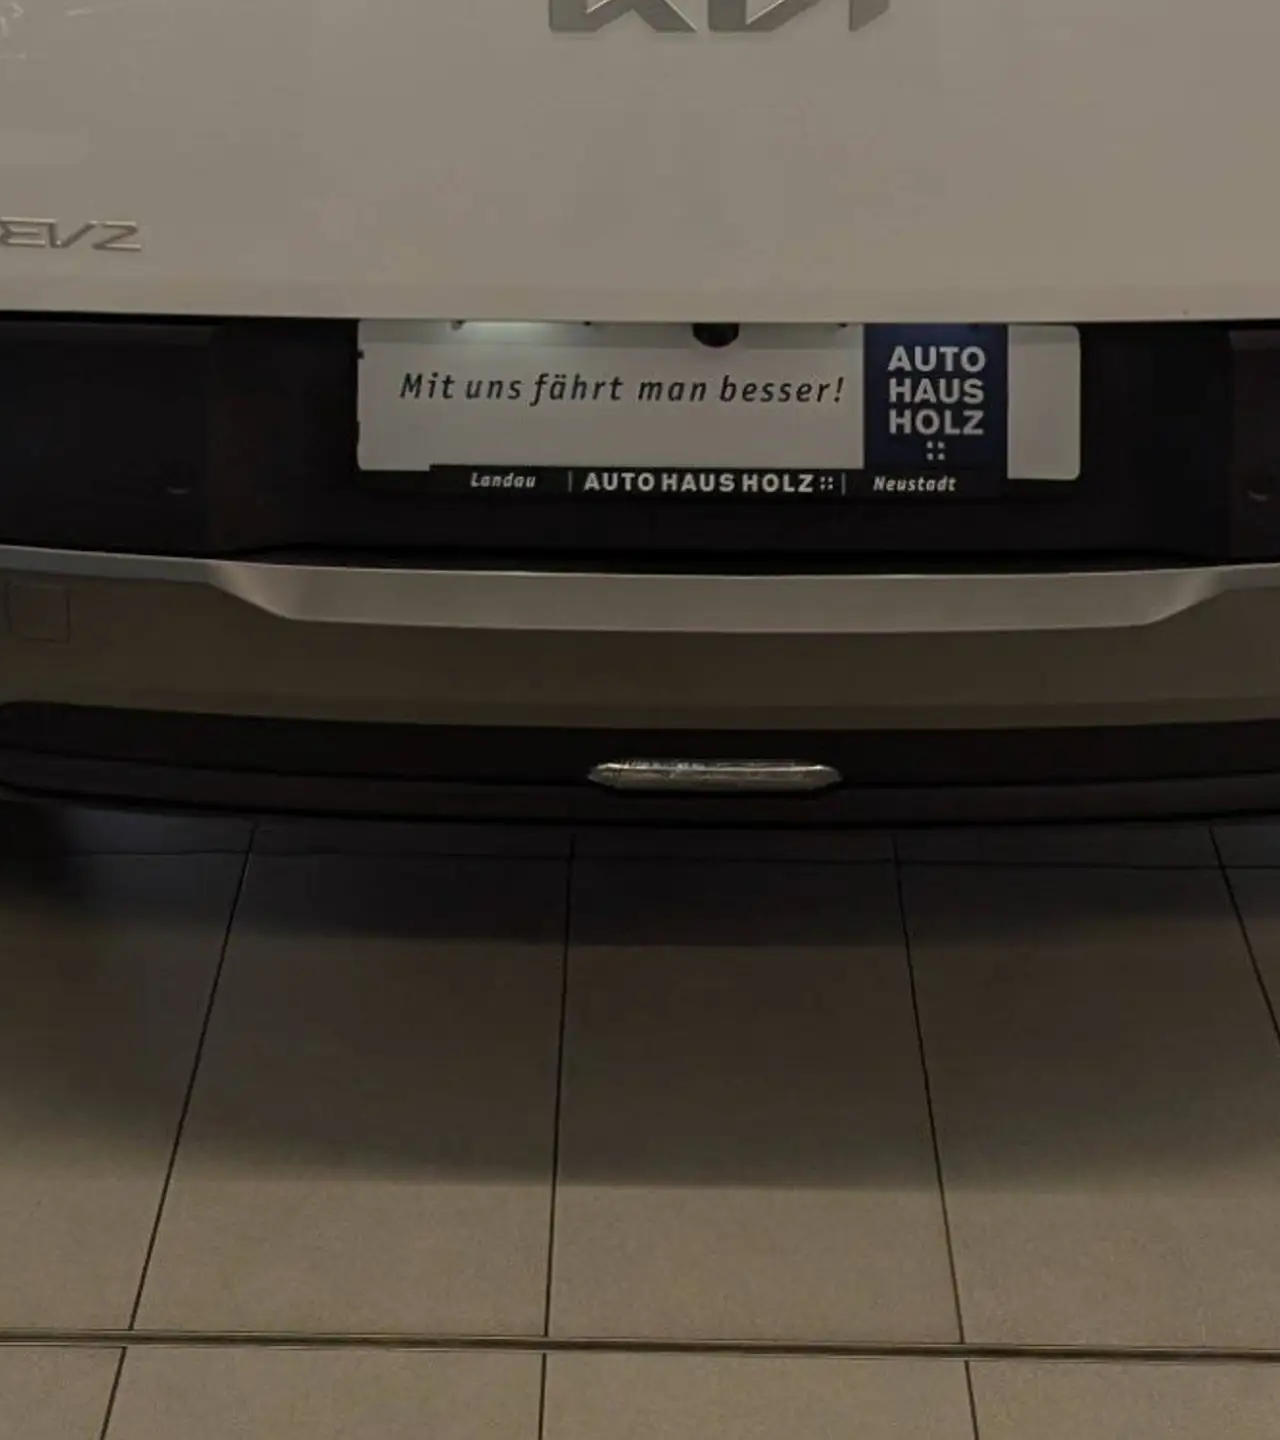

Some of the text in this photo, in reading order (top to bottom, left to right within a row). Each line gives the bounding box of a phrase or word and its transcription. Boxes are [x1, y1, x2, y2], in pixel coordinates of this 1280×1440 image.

[887, 345, 986, 373] AUTO
[400, 372, 845, 407] Mit uns fährt man besser!
[888, 377, 985, 404] HAUS
[888, 408, 985, 435] HOLZ
[470, 471, 958, 493] Landau AUTO HAUS HOLZ Neustadt
